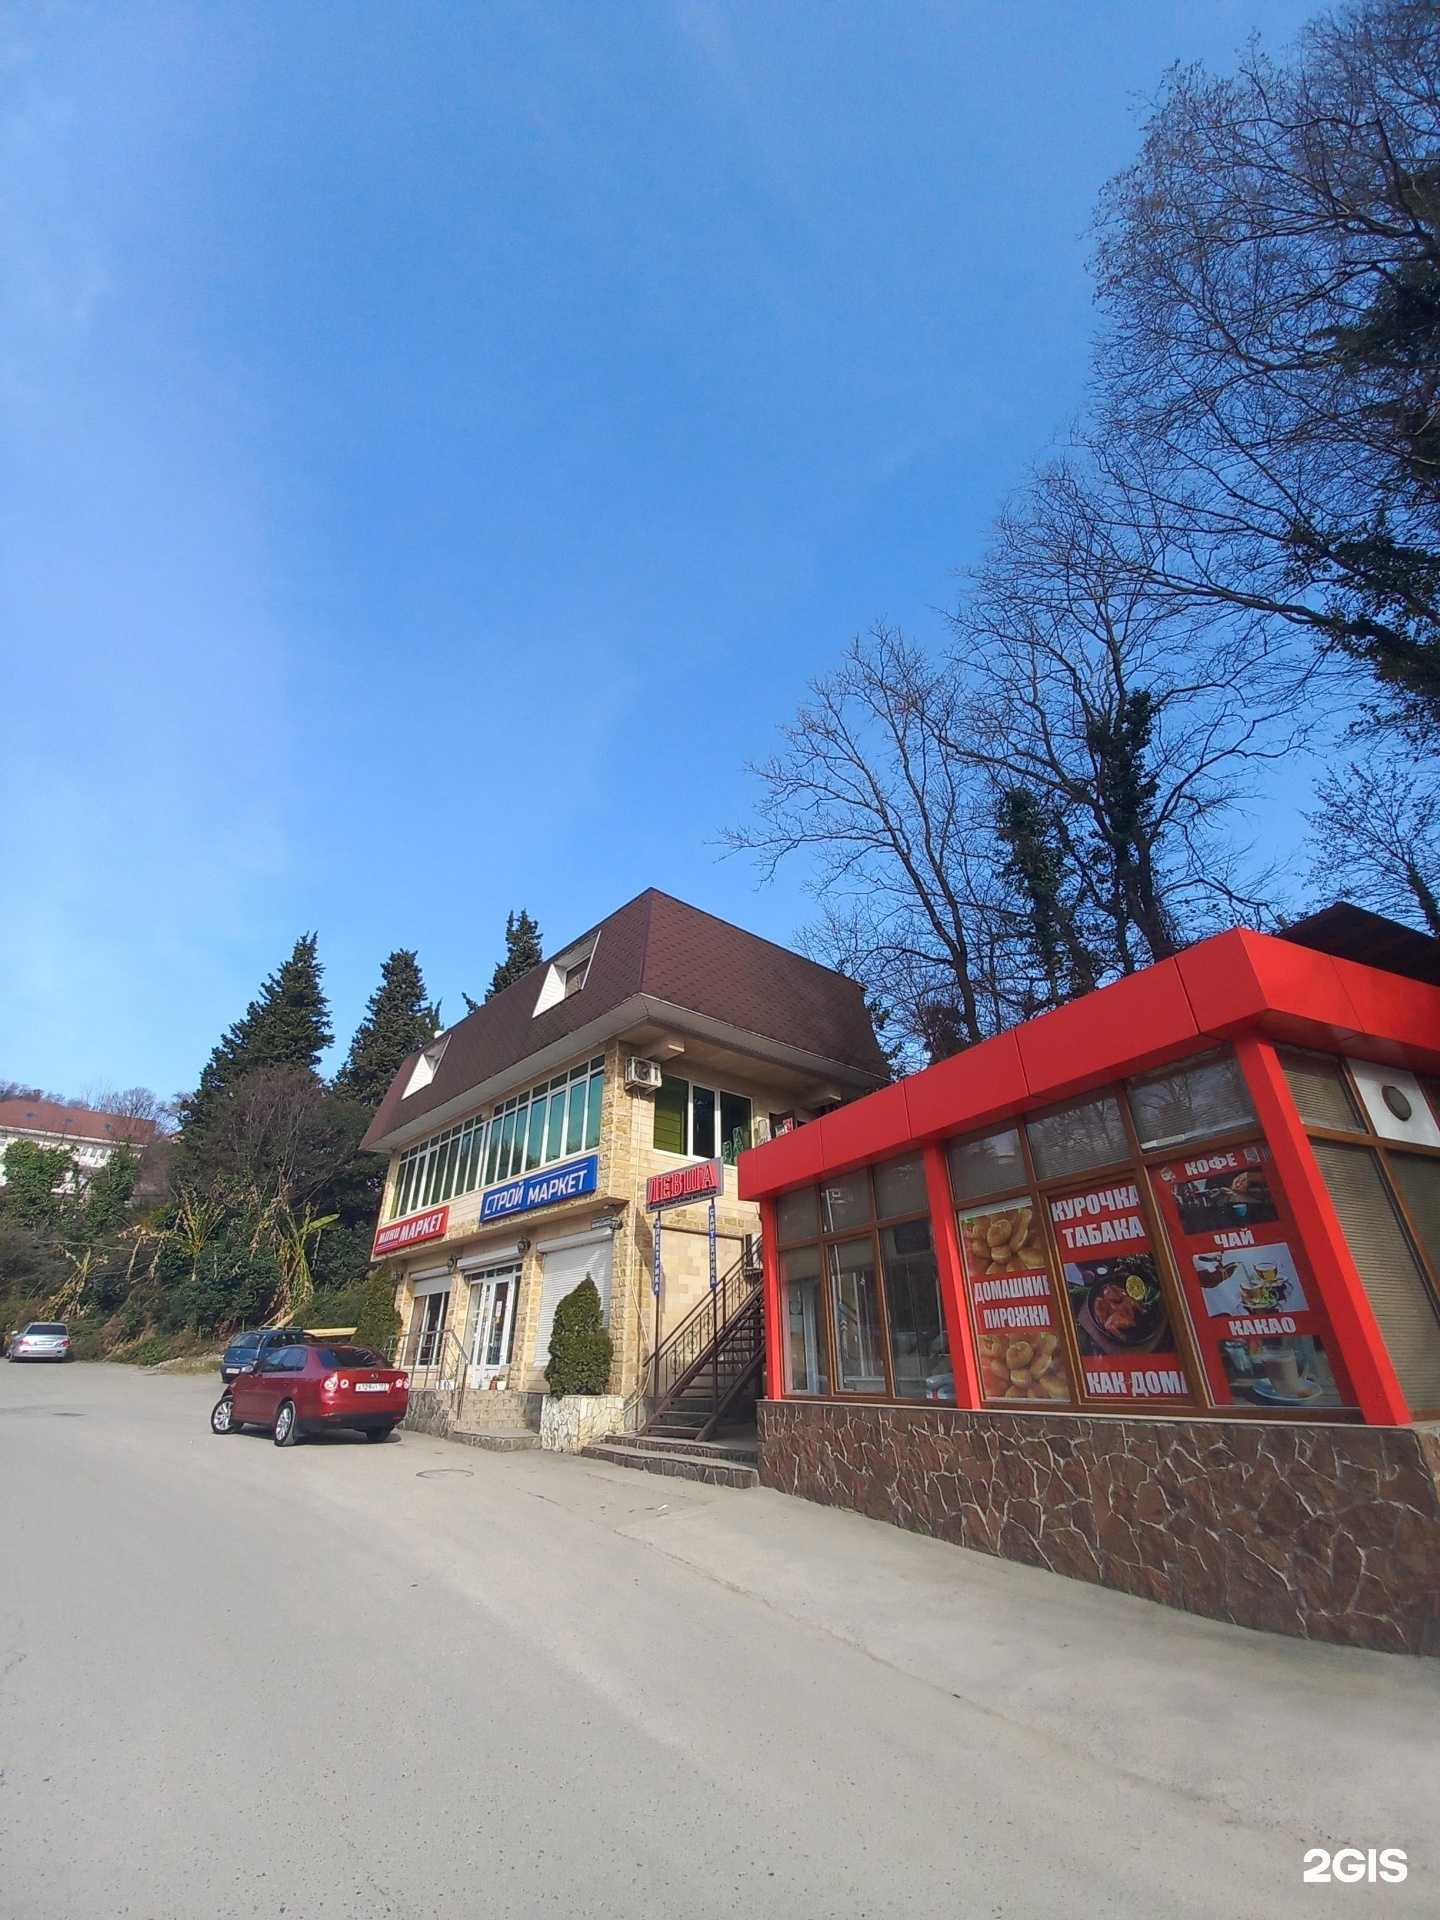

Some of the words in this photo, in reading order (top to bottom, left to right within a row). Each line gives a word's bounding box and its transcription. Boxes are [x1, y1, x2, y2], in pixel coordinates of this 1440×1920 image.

[1184, 1152, 1238, 1177] КОФЕ
[484, 1181, 525, 1215] СТРОЙ
[527, 1169, 588, 1205] МАРКЕТ
[649, 1163, 717, 1203] ЛЕВША
[1051, 1184, 1140, 1223] КУРОЧКА
[399, 1212, 444, 1243] МАРКЕТ
[1062, 1215, 1146, 1249] ТАБАКА
[1213, 1227, 1255, 1248] ЧАЙ
[983, 1304, 1051, 1329] ПИРОЖКИ
[1228, 1316, 1297, 1337] КАКАО
[1086, 1371, 1128, 1395] КАК
